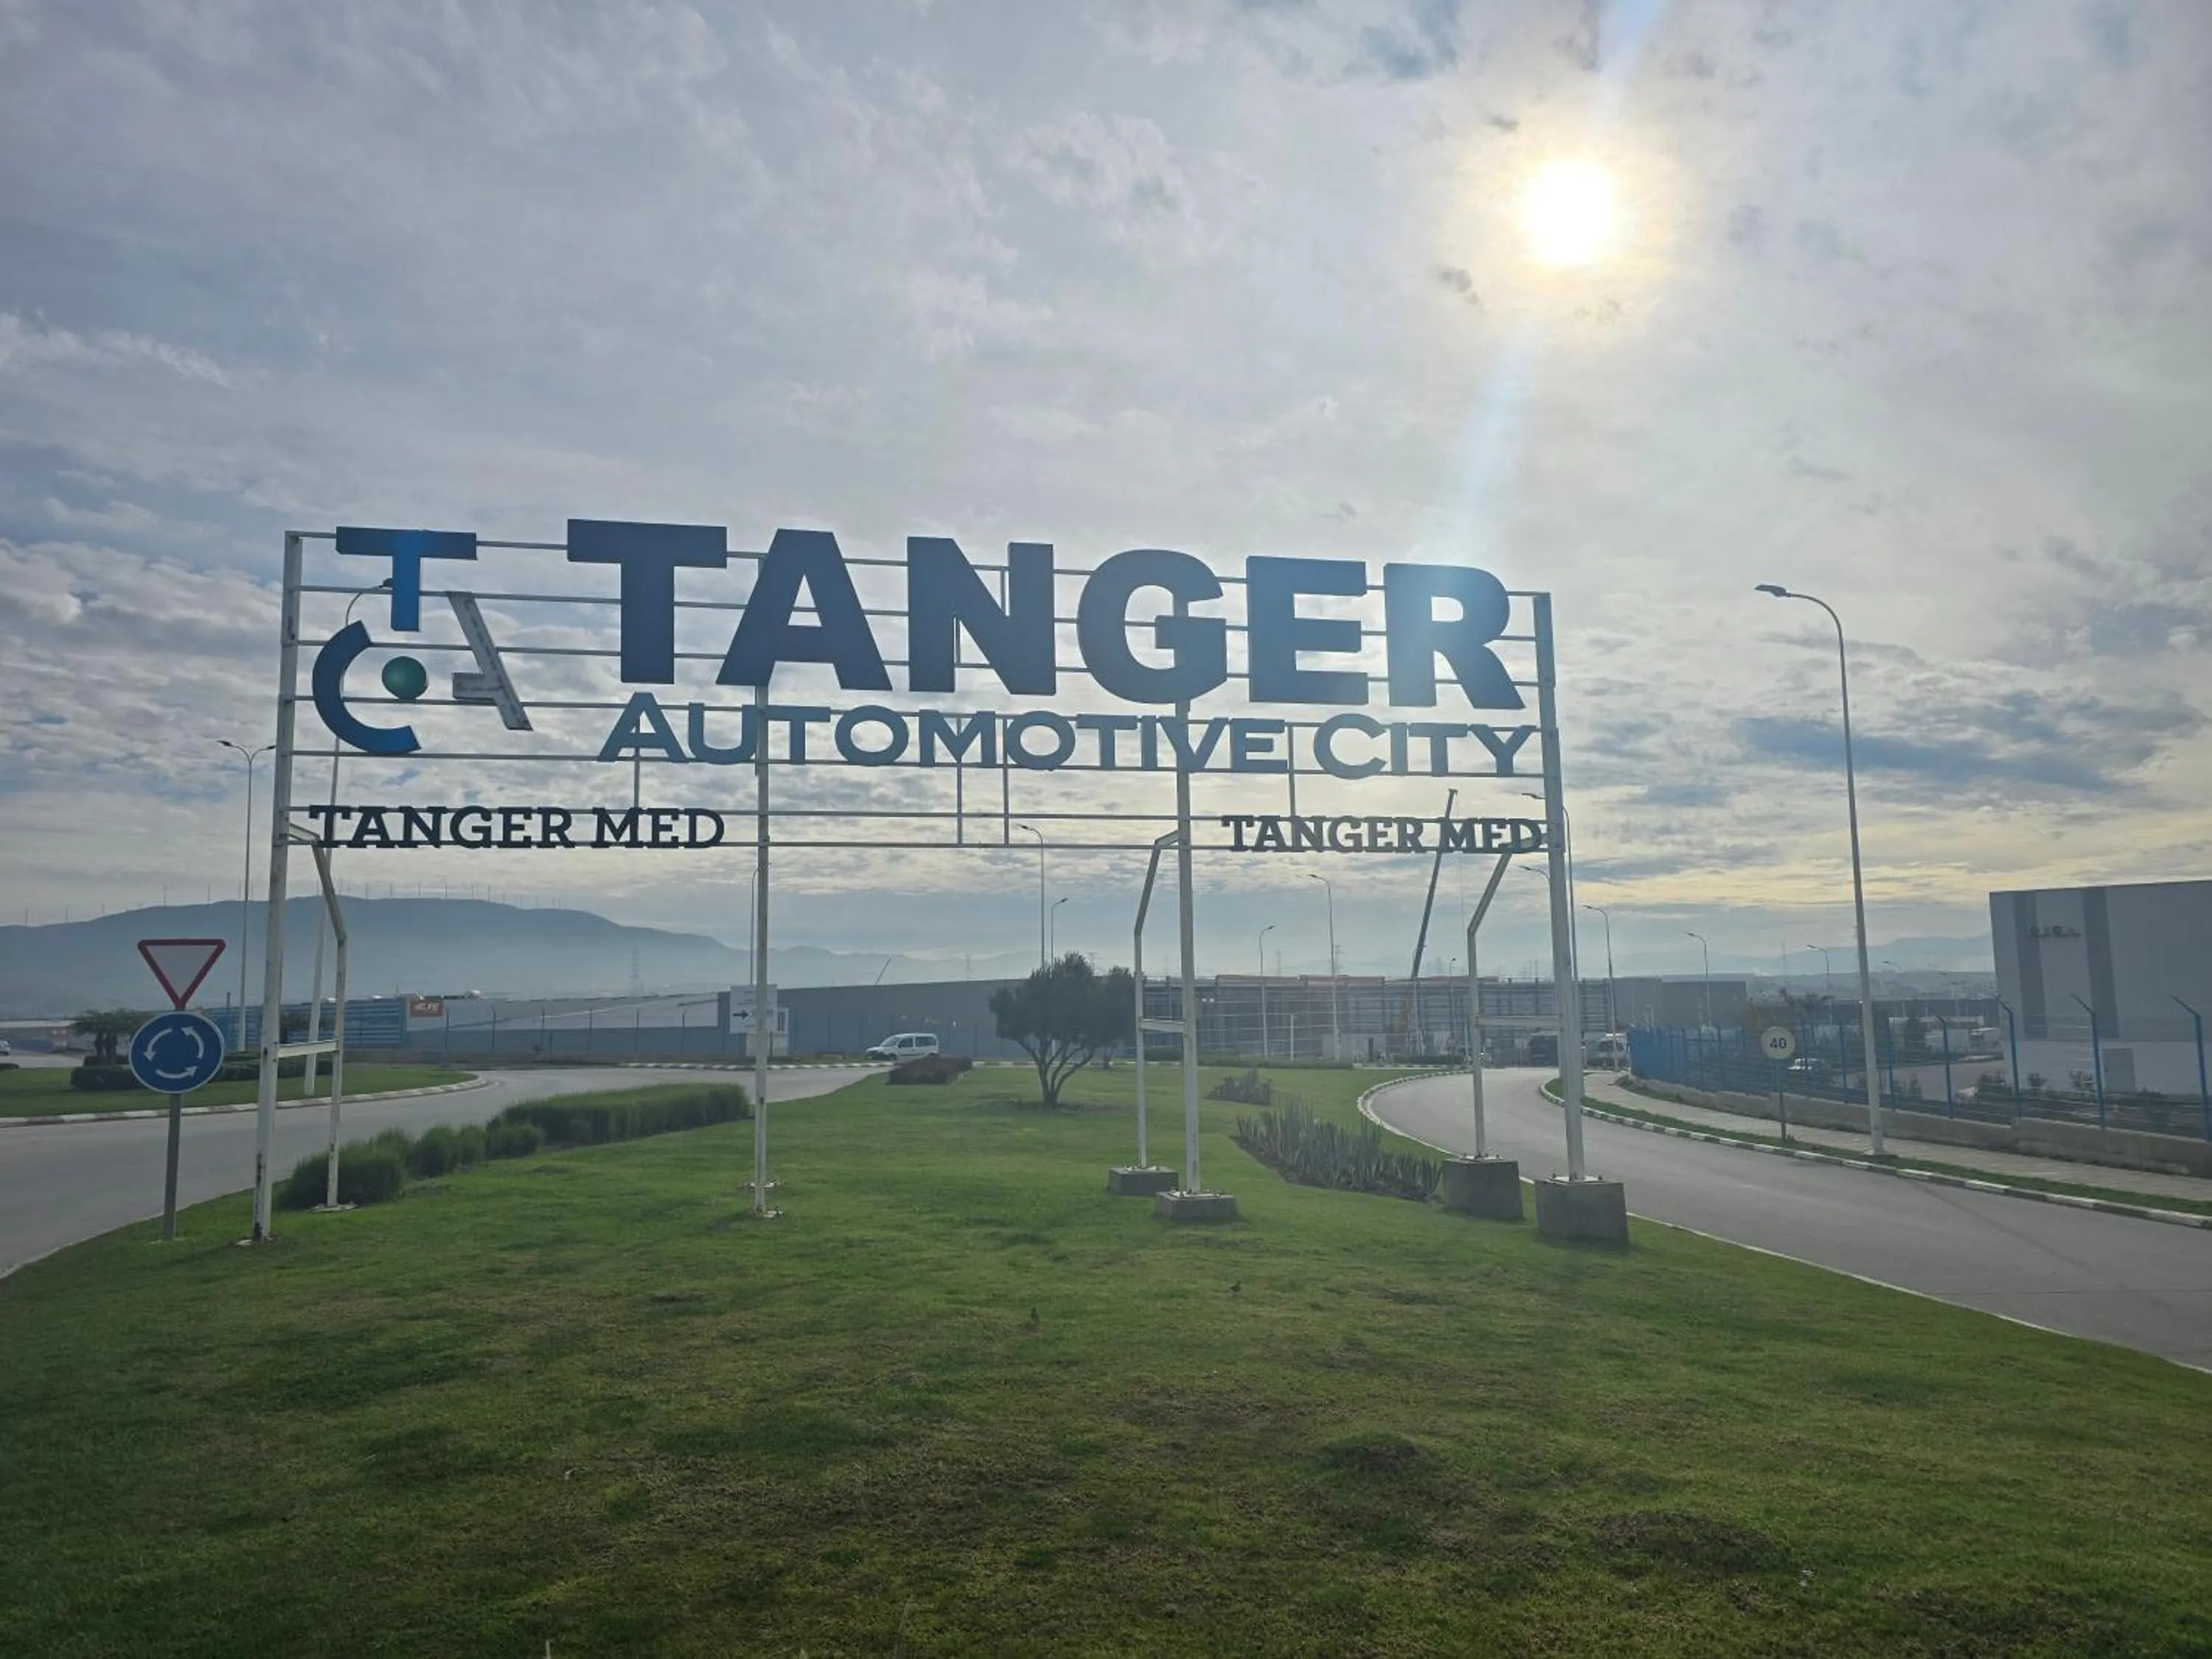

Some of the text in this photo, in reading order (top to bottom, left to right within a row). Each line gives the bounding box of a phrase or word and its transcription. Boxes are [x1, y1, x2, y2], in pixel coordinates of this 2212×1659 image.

[567, 518, 1526, 710] TANGER
[597, 692, 1540, 780] AUTOMOTIVE CITY
[309, 805, 726, 849] TANGER MED
[1222, 815, 1543, 854] TANGER MED
[1770, 1037, 1787, 1049] 40
